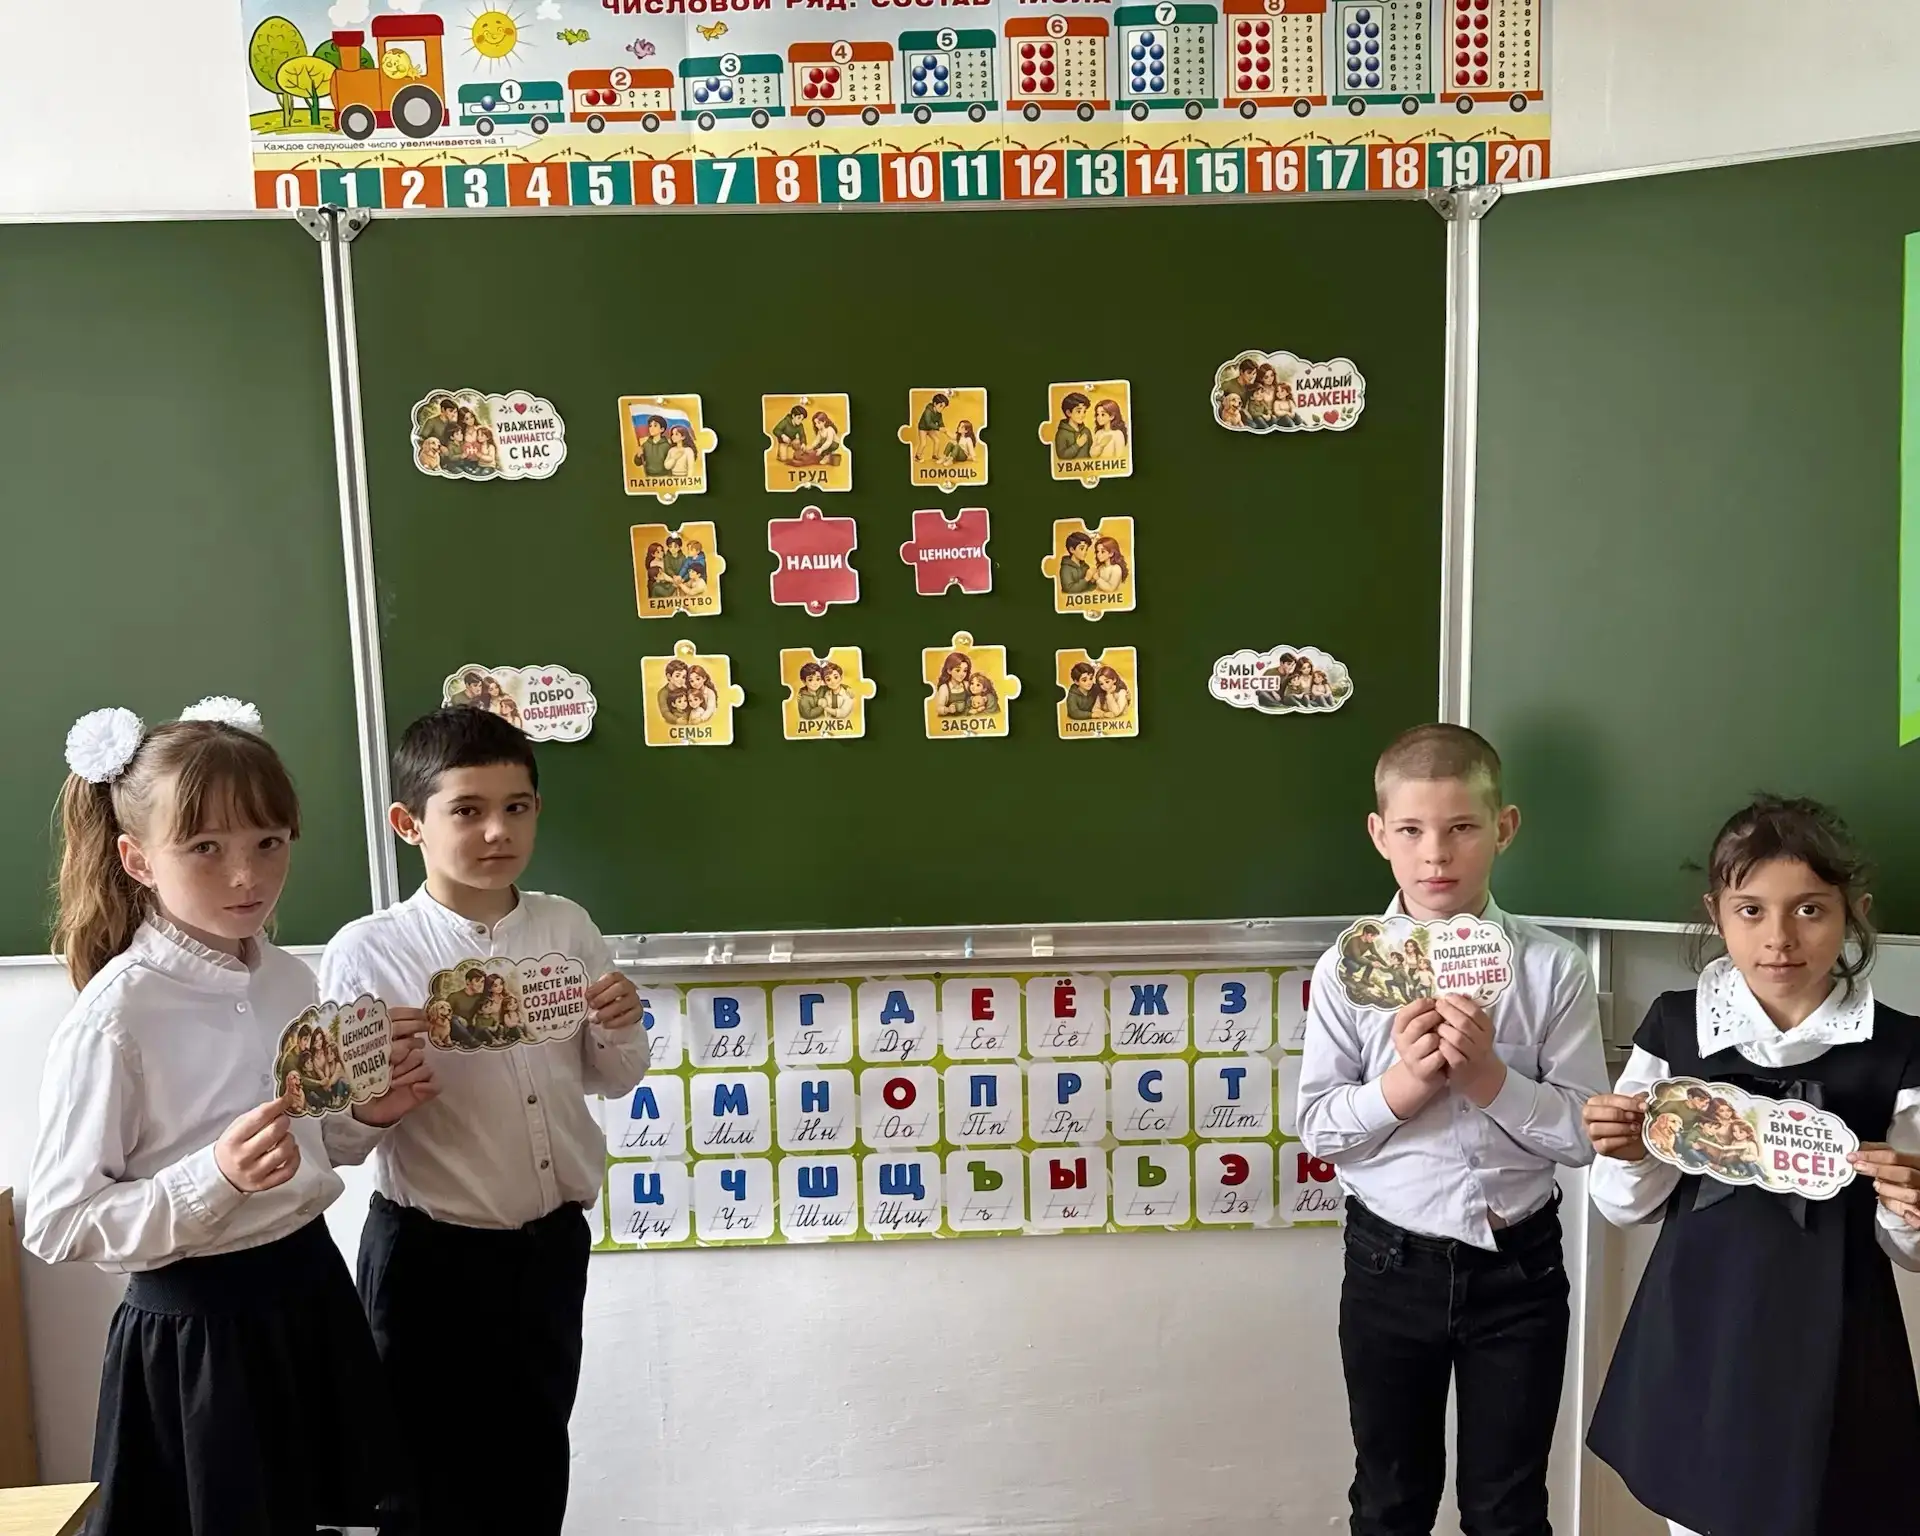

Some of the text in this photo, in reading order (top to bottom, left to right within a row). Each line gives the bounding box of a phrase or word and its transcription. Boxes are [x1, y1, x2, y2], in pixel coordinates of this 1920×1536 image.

[1160, 7, 1171, 20] 7
[1052, 19, 1063, 33] 6
[942, 33, 953, 46] 5
[835, 46, 847, 59] 4
[724, 58, 736, 73] 3
[615, 71, 628, 87] 2
[506, 85, 515, 98] 1
[544, 102, 549, 110] 1
[264, 143, 304, 151] Каждое
[307, 142, 365, 151] следующее
[401, 139, 481, 149] увеличивается
[311, 127, 1497, 163] +1 +1 +1 +1 +1 +1 +1 +1 +1 +1 +1 +1 +1 +1 +1 +1 +1 +1 +1
[276, 144, 1542, 209] 0 1 2 3 4 5 6 7 8 9 10 11 12 13 14 15 16 17 18 19 20
[1296, 374, 1352, 391] КАЖДЫЙ
[1297, 389, 1356, 408] ВАЖЕН!
[496, 418, 555, 432] УВАЖЕНИЕ
[510, 444, 550, 459] С НАС
[788, 470, 828, 482] ТРУД
[920, 467, 977, 480] ПОМОЩЬ
[1057, 459, 1127, 473] УВАЖЕНИЕ
[630, 476, 702, 488] ПАТРИОТИЗМ
[786, 554, 843, 570] НАШИ
[919, 547, 981, 562] ЦЕННОСТИ
[649, 596, 712, 609] ЕДИНСТВО
[1065, 592, 1123, 607] ДОВЕРИЕ
[1229, 664, 1254, 676] МЫ
[1220, 677, 1279, 690] ВМЕСТЕ!
[529, 688, 574, 705] ДОБРО
[669, 726, 712, 739] СЕМЬЯ
[797, 719, 853, 733] ДРУЖБА
[941, 718, 996, 732] ЗАБОТА
[1065, 720, 1132, 733] ПОДДЕРЖКА
[1433, 942, 1501, 960] ПОДДЕРЖКА
[1441, 956, 1499, 973] ДЕЛАЕТ НАС
[522, 974, 582, 995] ВМЕСТЕ МЫ
[1437, 968, 1507, 989] СИЛЬНЕЕ!
[523, 986, 582, 1009] СОЗДАЁМ
[880, 990, 914, 1024] Д
[971, 988, 994, 1021] Е
[1053, 979, 1077, 1018] Ё
[1129, 984, 1169, 1015] Ж
[1220, 982, 1247, 1014] З
[528, 1001, 584, 1023] БУДУЩЕЕ!
[713, 997, 741, 1029] В
[800, 994, 825, 1026] Г
[342, 1019, 384, 1047] ЦЕННОСТИ
[352, 1050, 386, 1079] ЛЮДЕЙ
[883, 1077, 916, 1110] О
[970, 1075, 997, 1107] П
[1057, 1072, 1082, 1104] Р
[1138, 1070, 1163, 1102] С
[1220, 1067, 1246, 1100] Т
[630, 1086, 660, 1120] Л
[713, 1084, 749, 1116] М
[801, 1081, 829, 1113] Н
[1770, 1121, 1833, 1140] ВМЕСТЕ
[1763, 1133, 1843, 1154] МЫ МОЖЕМ
[1049, 1157, 1087, 1190] Ы
[1138, 1156, 1167, 1187] Ь
[1220, 1153, 1249, 1186] Э
[1297, 1152, 1336, 1183] Ю
[1773, 1149, 1835, 1178] ВСЁ!
[721, 1169, 746, 1201] Ч
[798, 1166, 839, 1198] Ш
[879, 1163, 925, 1200] Щ
[967, 1161, 1003, 1192] Ъ
[633, 1173, 664, 1205] Ц
